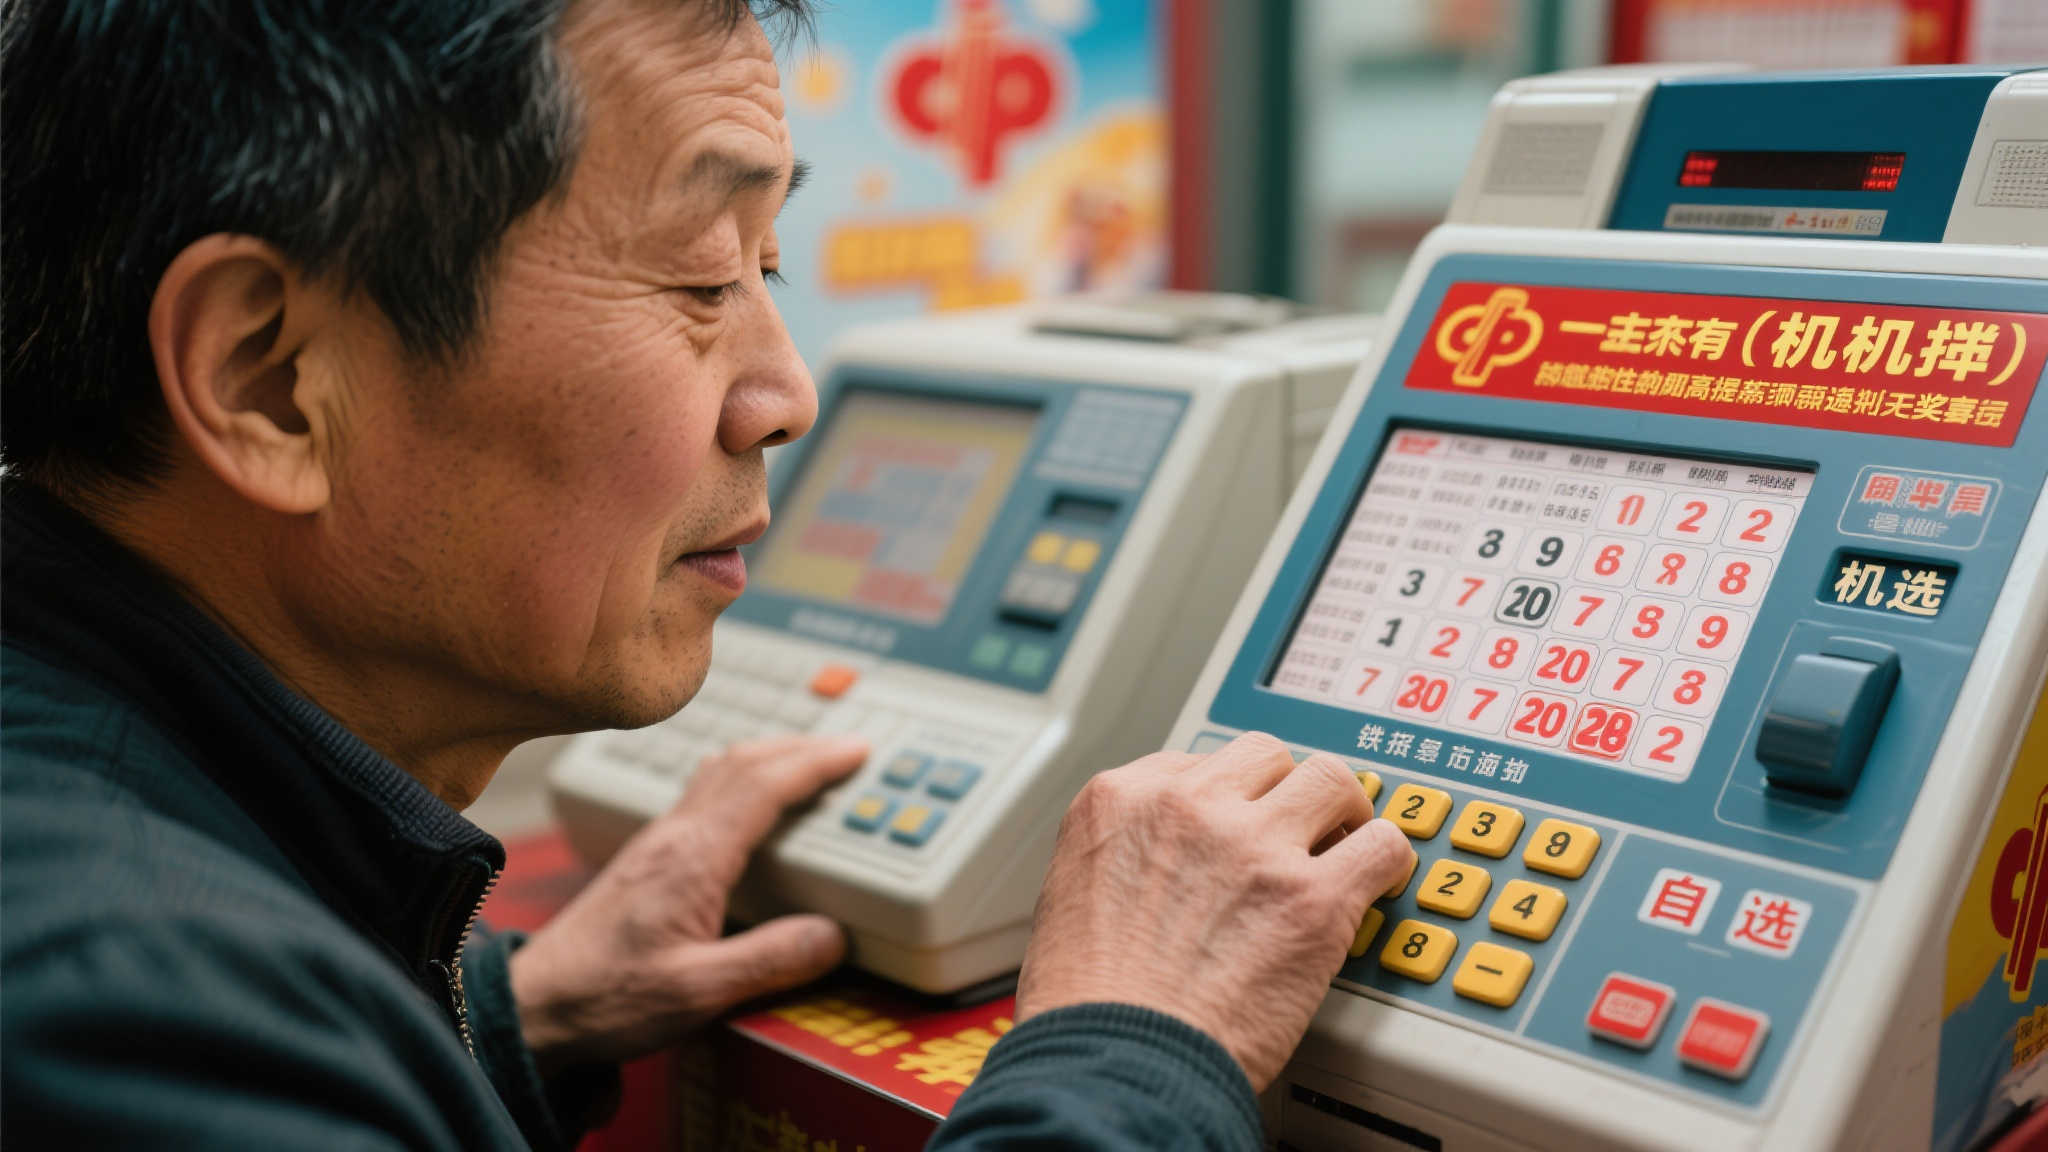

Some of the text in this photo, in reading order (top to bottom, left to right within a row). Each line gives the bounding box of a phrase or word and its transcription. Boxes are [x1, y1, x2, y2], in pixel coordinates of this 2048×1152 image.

[1676, 500, 1708, 533] 2
[1739, 509, 1773, 542] 2
[1535, 537, 1564, 567] 9
[1594, 544, 1625, 576] 6
[1719, 561, 1751, 595] 8
[1834, 560, 1947, 616] 机选
[1400, 569, 1426, 597] 3
[1457, 576, 1485, 607] 7
[1503, 584, 1551, 621] 20
[1573, 595, 1605, 627] 7
[1696, 615, 1729, 649] 9
[1377, 617, 1402, 647] 1
[1429, 626, 1461, 658] 2
[1488, 637, 1519, 669] 8
[1536, 645, 1590, 684] 20
[1612, 657, 1645, 691] 7
[1356, 667, 1382, 696] 7
[1467, 687, 1499, 721] 7
[1513, 697, 1568, 739] 20
[1648, 726, 1684, 763] 2
[1400, 795, 1425, 820] 2
[1472, 811, 1497, 837] 3
[1437, 871, 1538, 919] 2 4
[1649, 875, 1800, 950] 自选
[1401, 932, 1429, 958] 8
